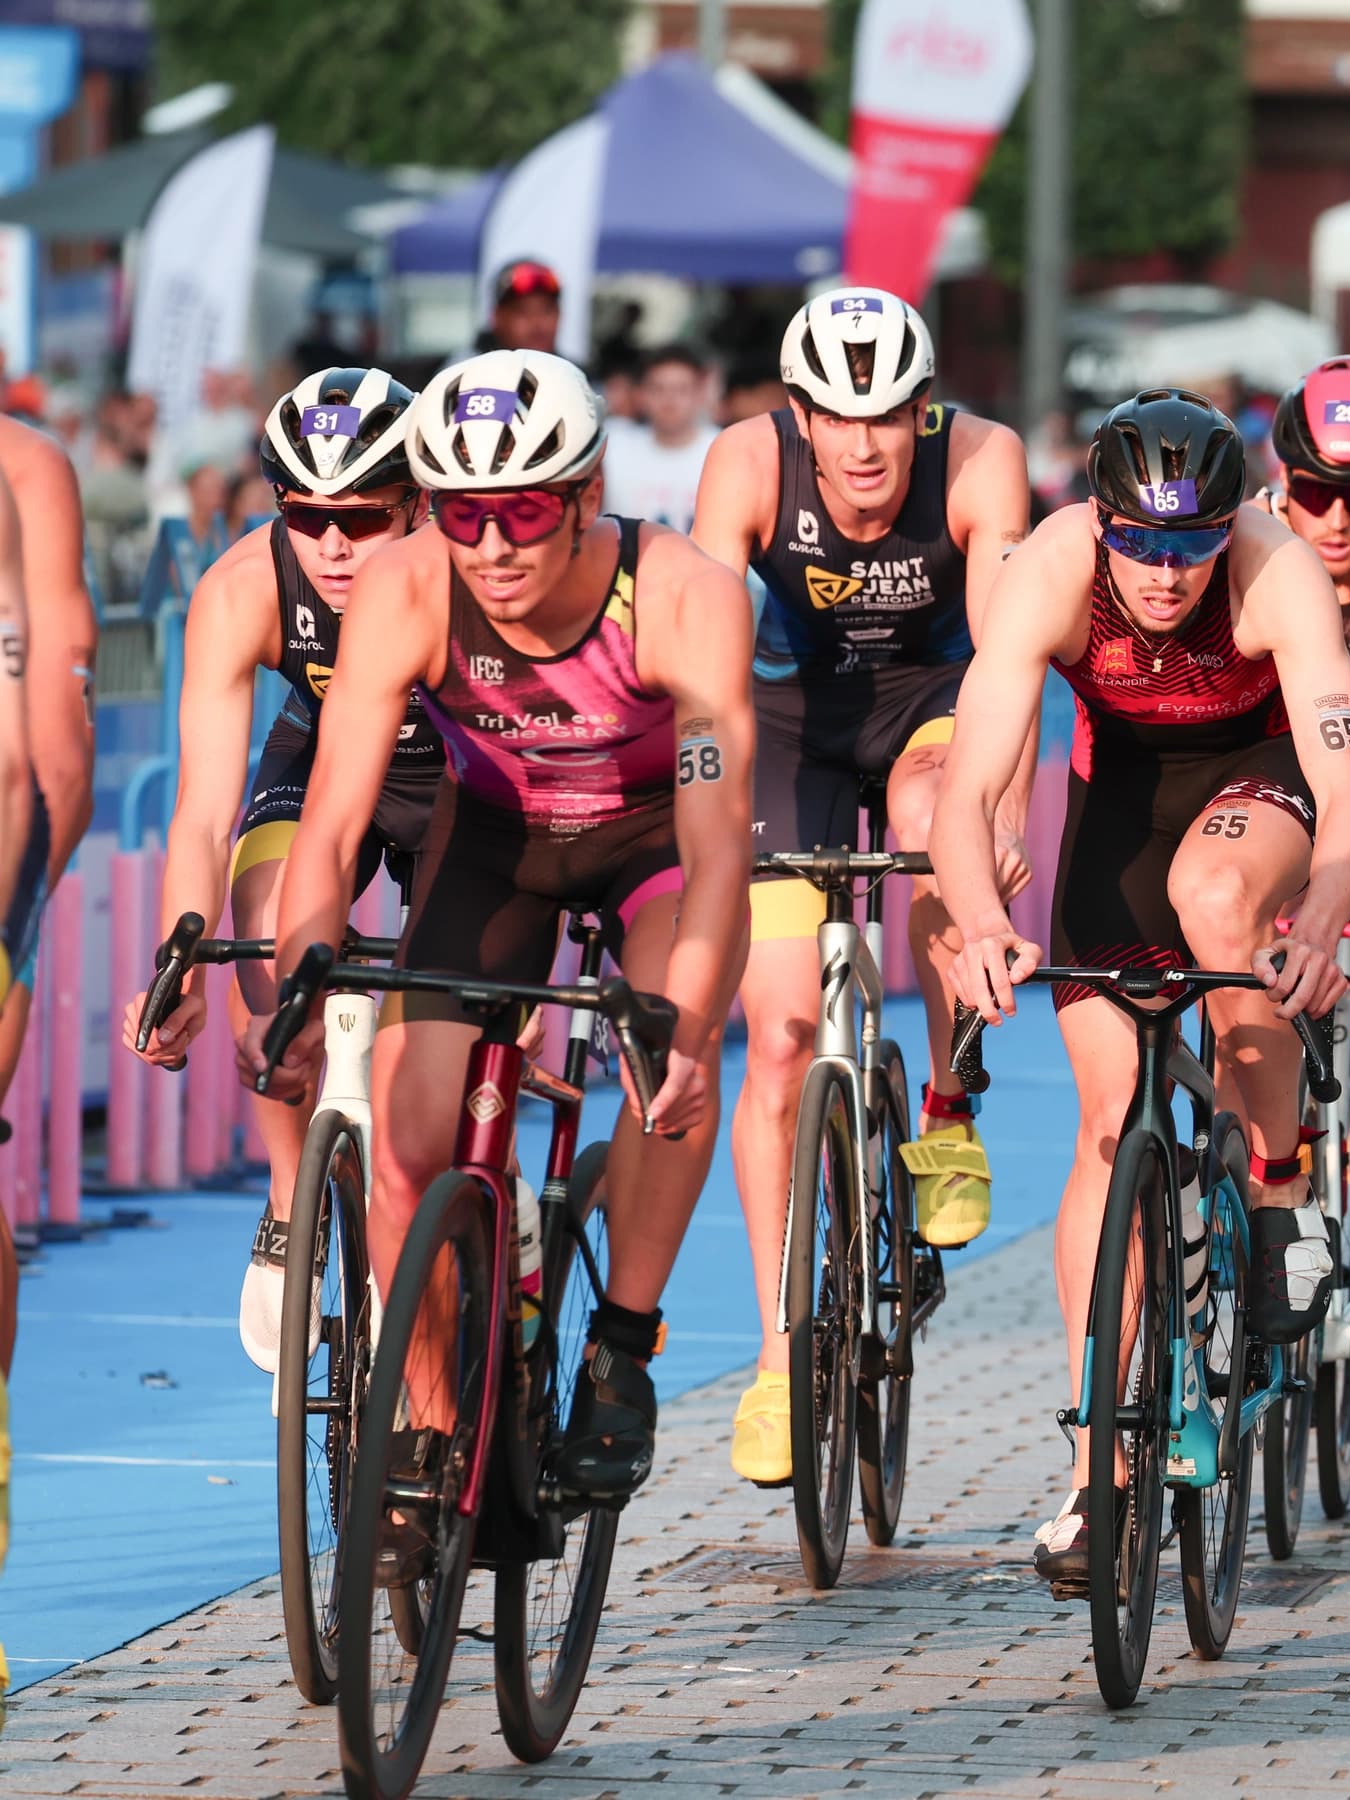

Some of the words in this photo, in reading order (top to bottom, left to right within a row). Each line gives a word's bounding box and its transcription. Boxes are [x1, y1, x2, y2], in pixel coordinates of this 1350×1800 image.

[843, 299, 867, 310] 34
[465, 395, 496, 416] 58
[313, 412, 338, 431] 31
[1154, 490, 1180, 512] 65
[851, 556, 924, 579] SAINT
[862, 576, 931, 595] JEAN
[851, 595, 870, 604] DE
[470, 655, 504, 681] LFCC
[1157, 701, 1231, 714] Evreux
[475, 714, 504, 729] Tri
[512, 712, 560, 728] Val
[500, 728, 538, 739] de
[548, 723, 627, 739] GRAY
[678, 746, 722, 786] 58
[1201, 814, 1249, 839] 65
